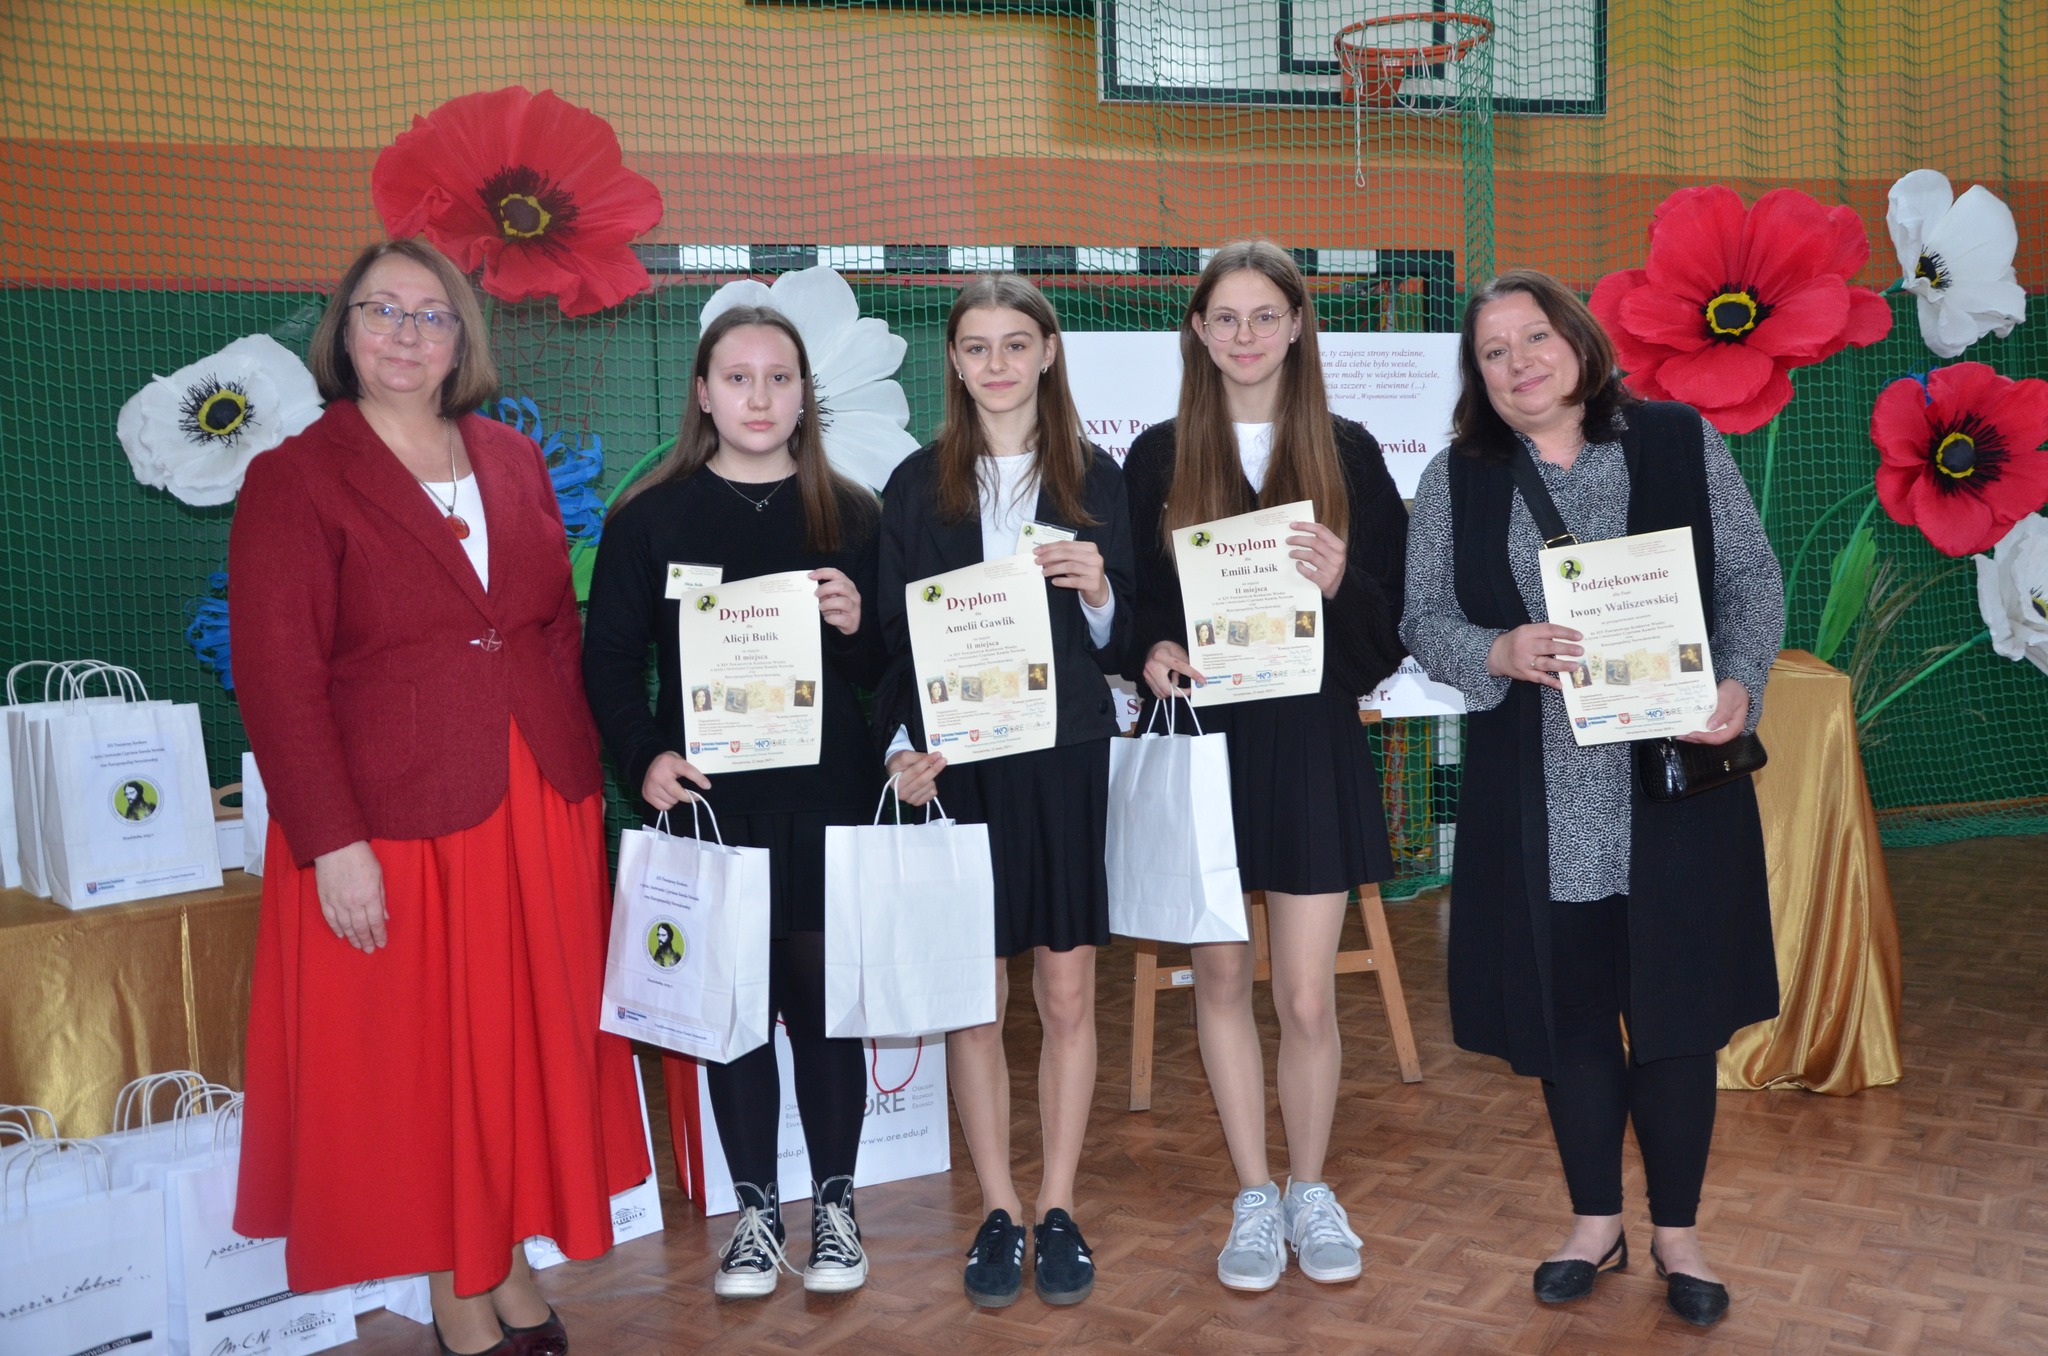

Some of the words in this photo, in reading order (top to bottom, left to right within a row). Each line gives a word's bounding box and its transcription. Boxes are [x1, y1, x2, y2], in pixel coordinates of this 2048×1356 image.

[1330, 350, 1337, 358] ty
[1338, 350, 1365, 358] czujesz
[1367, 350, 1389, 358] strony
[1391, 349, 1425, 358] rodzinne,
[1335, 360, 1347, 368] dla
[1349, 360, 1371, 368] ciebie
[1341, 371, 1365, 380] modły
[1374, 371, 1407, 380] wiejskim
[1086, 419, 1123, 435] XIV
[1379, 439, 1427, 454] rwida
[1215, 537, 1277, 557] Dyplom
[1221, 565, 1251, 578] Emilii
[1252, 563, 1279, 575] Jasik
[1571, 568, 1669, 593] Podziękowanie
[1243, 586, 1268, 594] miejsca
[946, 591, 1007, 612] Dyplom
[1569, 606, 1602, 618] Iwony
[1605, 592, 1679, 612] Waliszewskiej
[719, 605, 779, 623] Dyplom
[945, 620, 978, 634] Amelii
[980, 616, 1015, 629] Gawlik
[722, 633, 749, 644] Alicji
[752, 632, 779, 642] Bulik
[974, 641, 999, 649] miejsca
[777, 1146, 805, 1160] edu.pl
